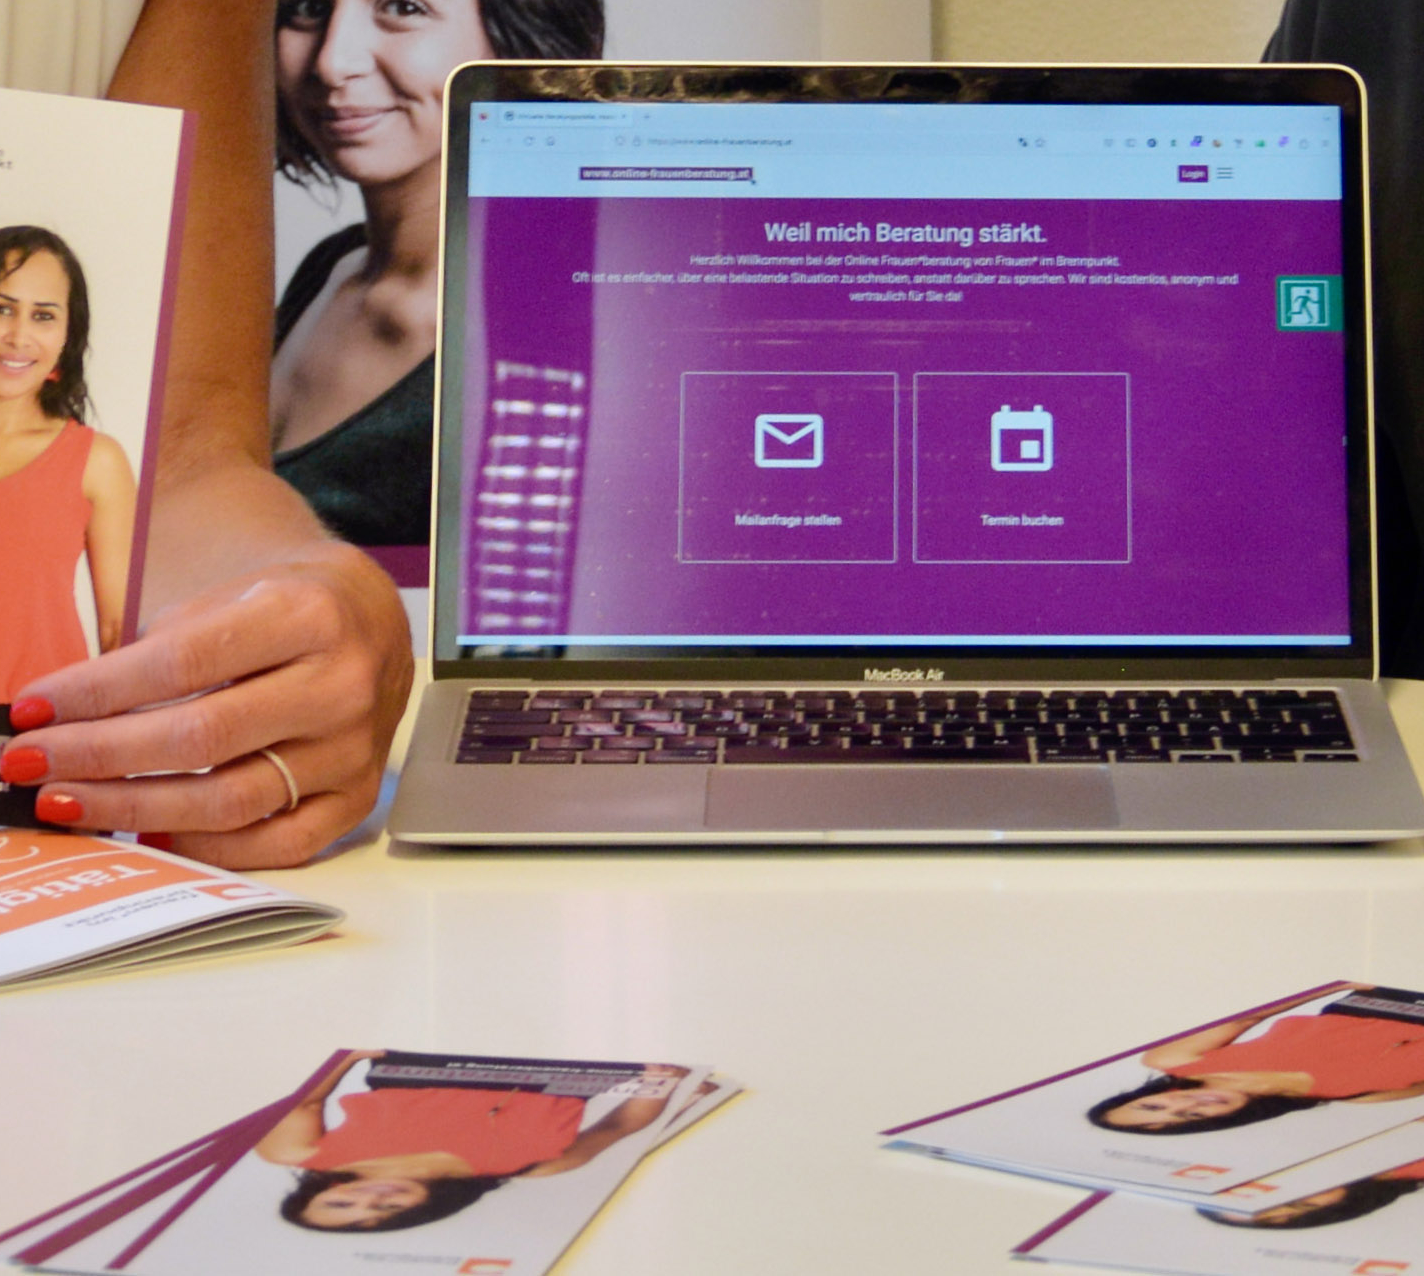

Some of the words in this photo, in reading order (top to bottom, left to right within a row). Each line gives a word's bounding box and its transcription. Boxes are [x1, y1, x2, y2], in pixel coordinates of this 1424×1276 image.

[582, 168, 751, 181] www.online-frauenberatung.at
[764, 222, 811, 243] Weil
[816, 222, 870, 243] mich
[877, 223, 974, 247] Beratung
[979, 223, 1048, 243] stärkt.
[735, 514, 802, 528] Mailanfrage
[804, 514, 842, 526] stellen
[980, 514, 1019, 526] Termin
[1021, 514, 1064, 527] buchen
[864, 668, 925, 681] MacBook
[927, 668, 945, 681] Air
